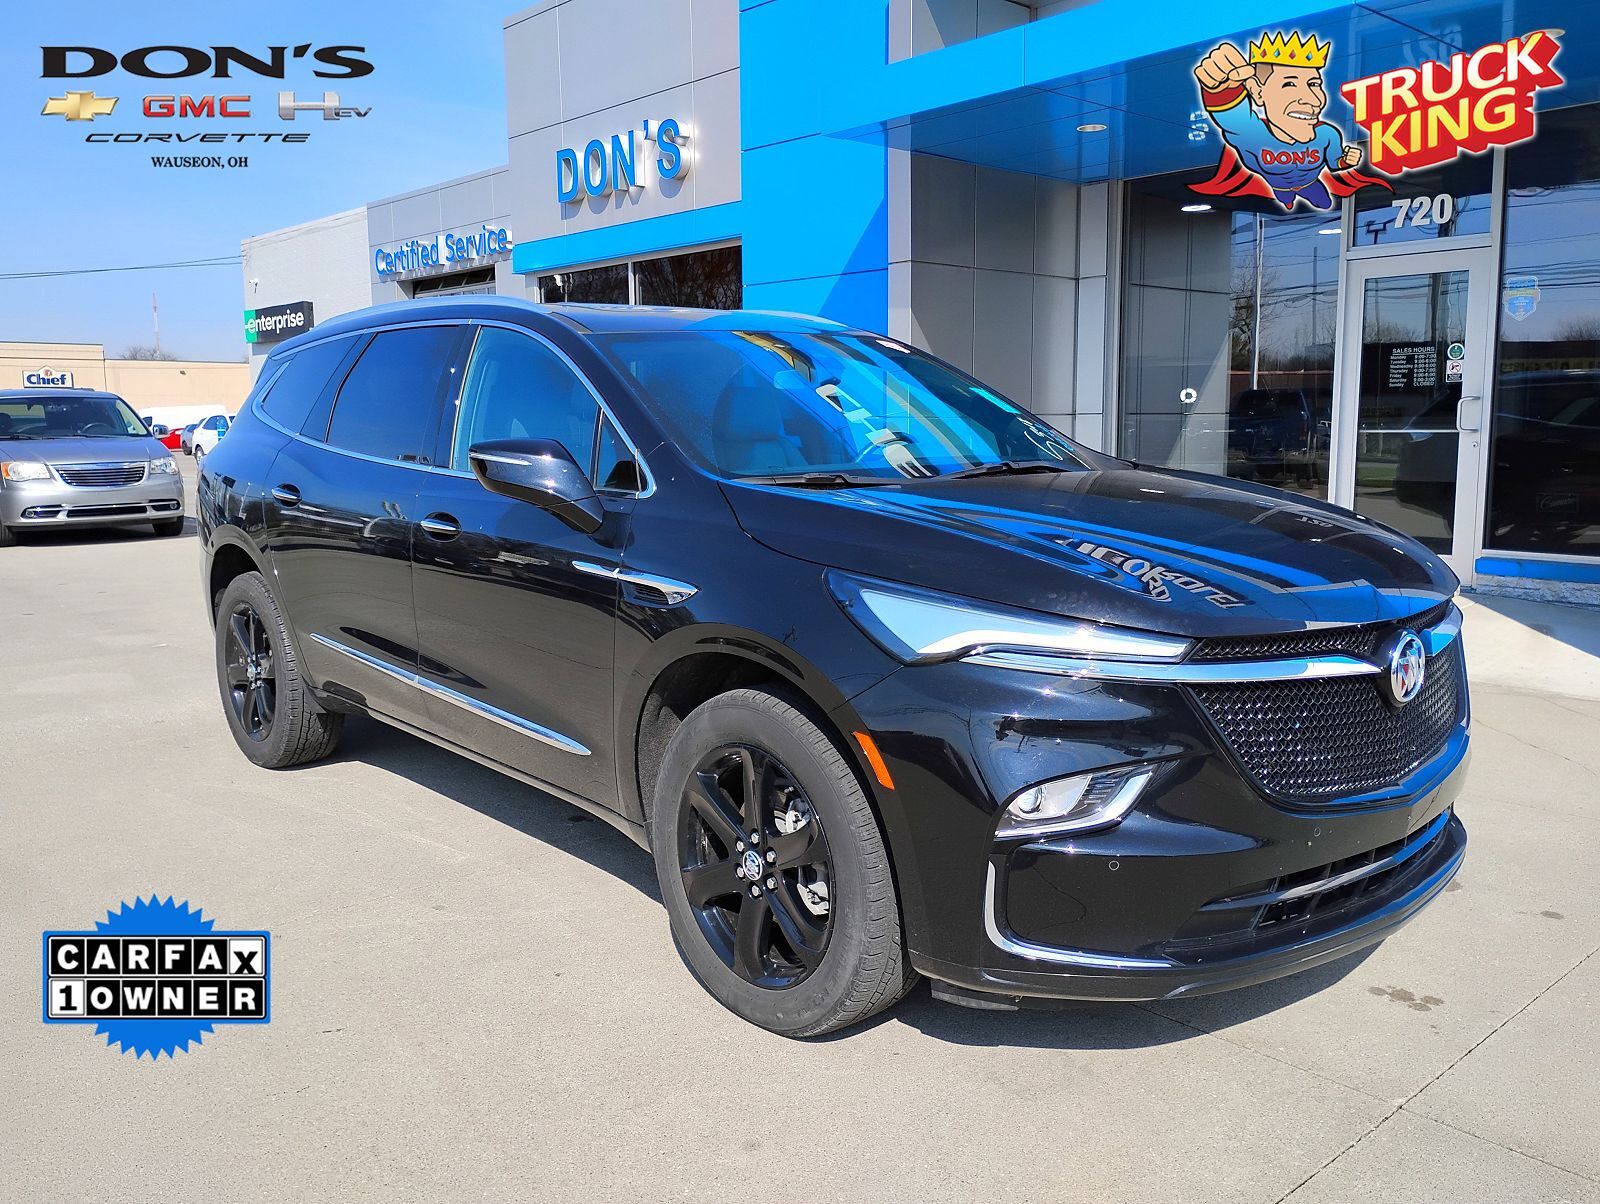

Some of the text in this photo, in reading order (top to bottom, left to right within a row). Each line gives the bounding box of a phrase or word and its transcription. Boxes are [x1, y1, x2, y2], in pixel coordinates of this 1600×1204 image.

[556, 118, 684, 204] DON'S
[1391, 193, 1454, 229] 720
[374, 224, 508, 276] Certified Service
[246, 308, 305, 334] enterprise
[26, 373, 67, 386] Chief
